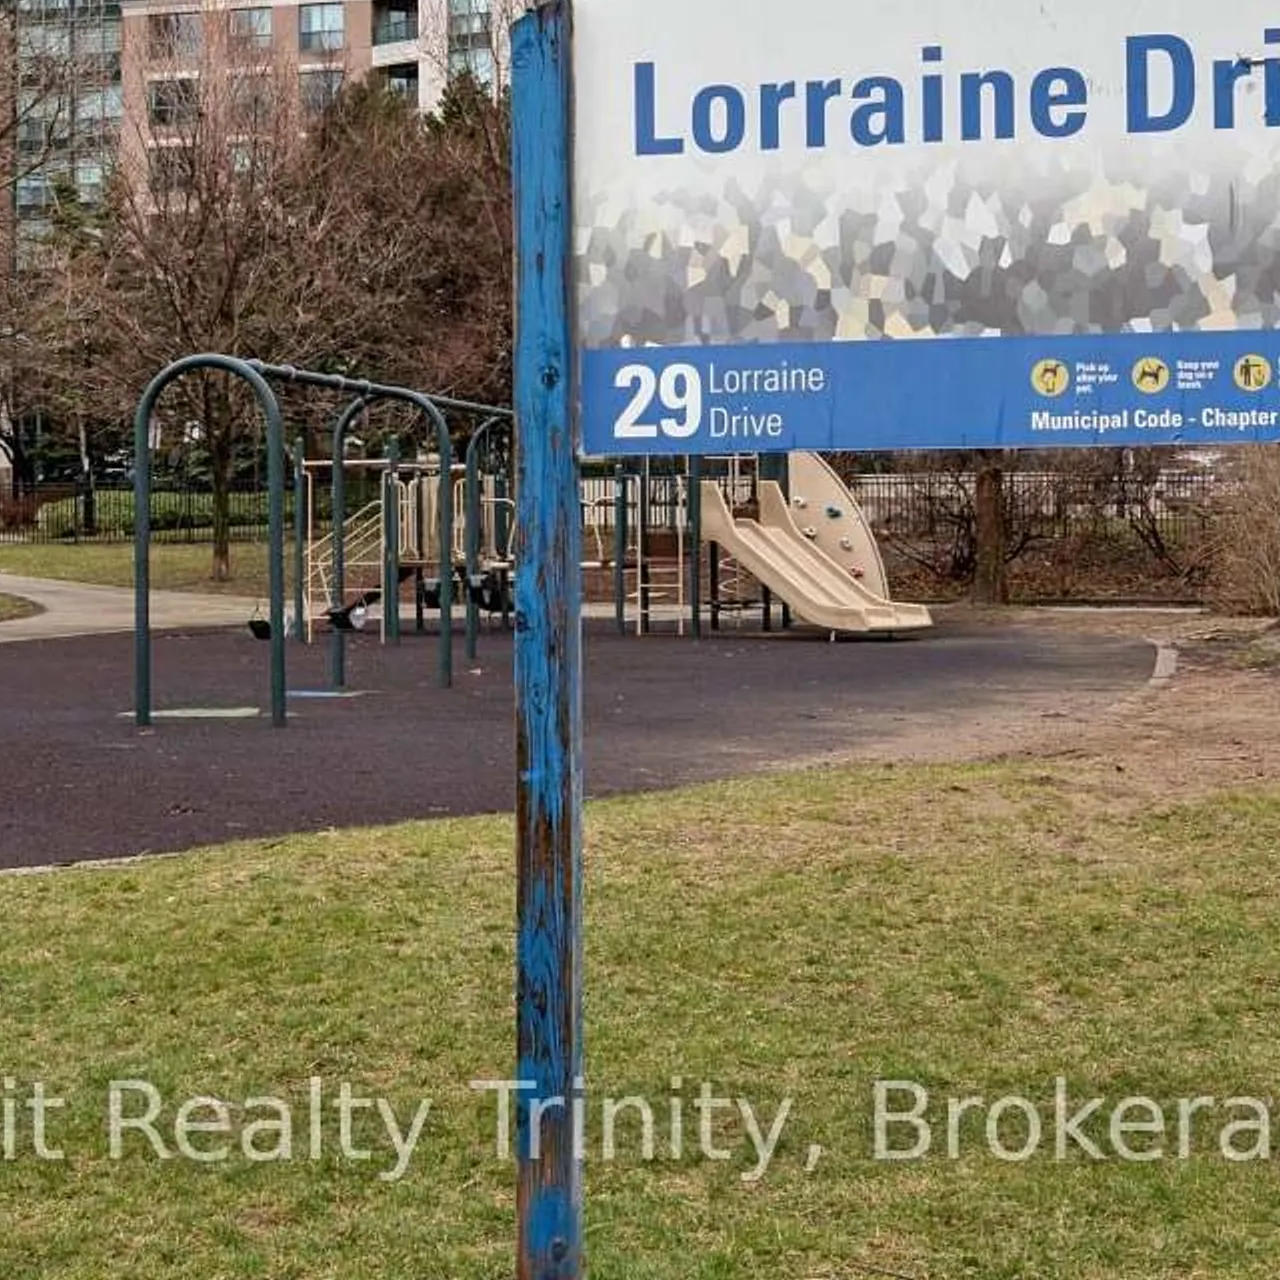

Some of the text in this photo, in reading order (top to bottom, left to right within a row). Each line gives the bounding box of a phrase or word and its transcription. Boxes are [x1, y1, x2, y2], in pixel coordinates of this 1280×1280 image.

[634, 47, 1087, 156] Lorraine
[709, 360, 824, 394] Lorraine
[614, 363, 701, 438] 29
[710, 406, 782, 438] Drive
[1031, 410, 1128, 433] Municipal
[1134, 410, 1183, 429] Code
[1202, 407, 1277, 430] Chapter
